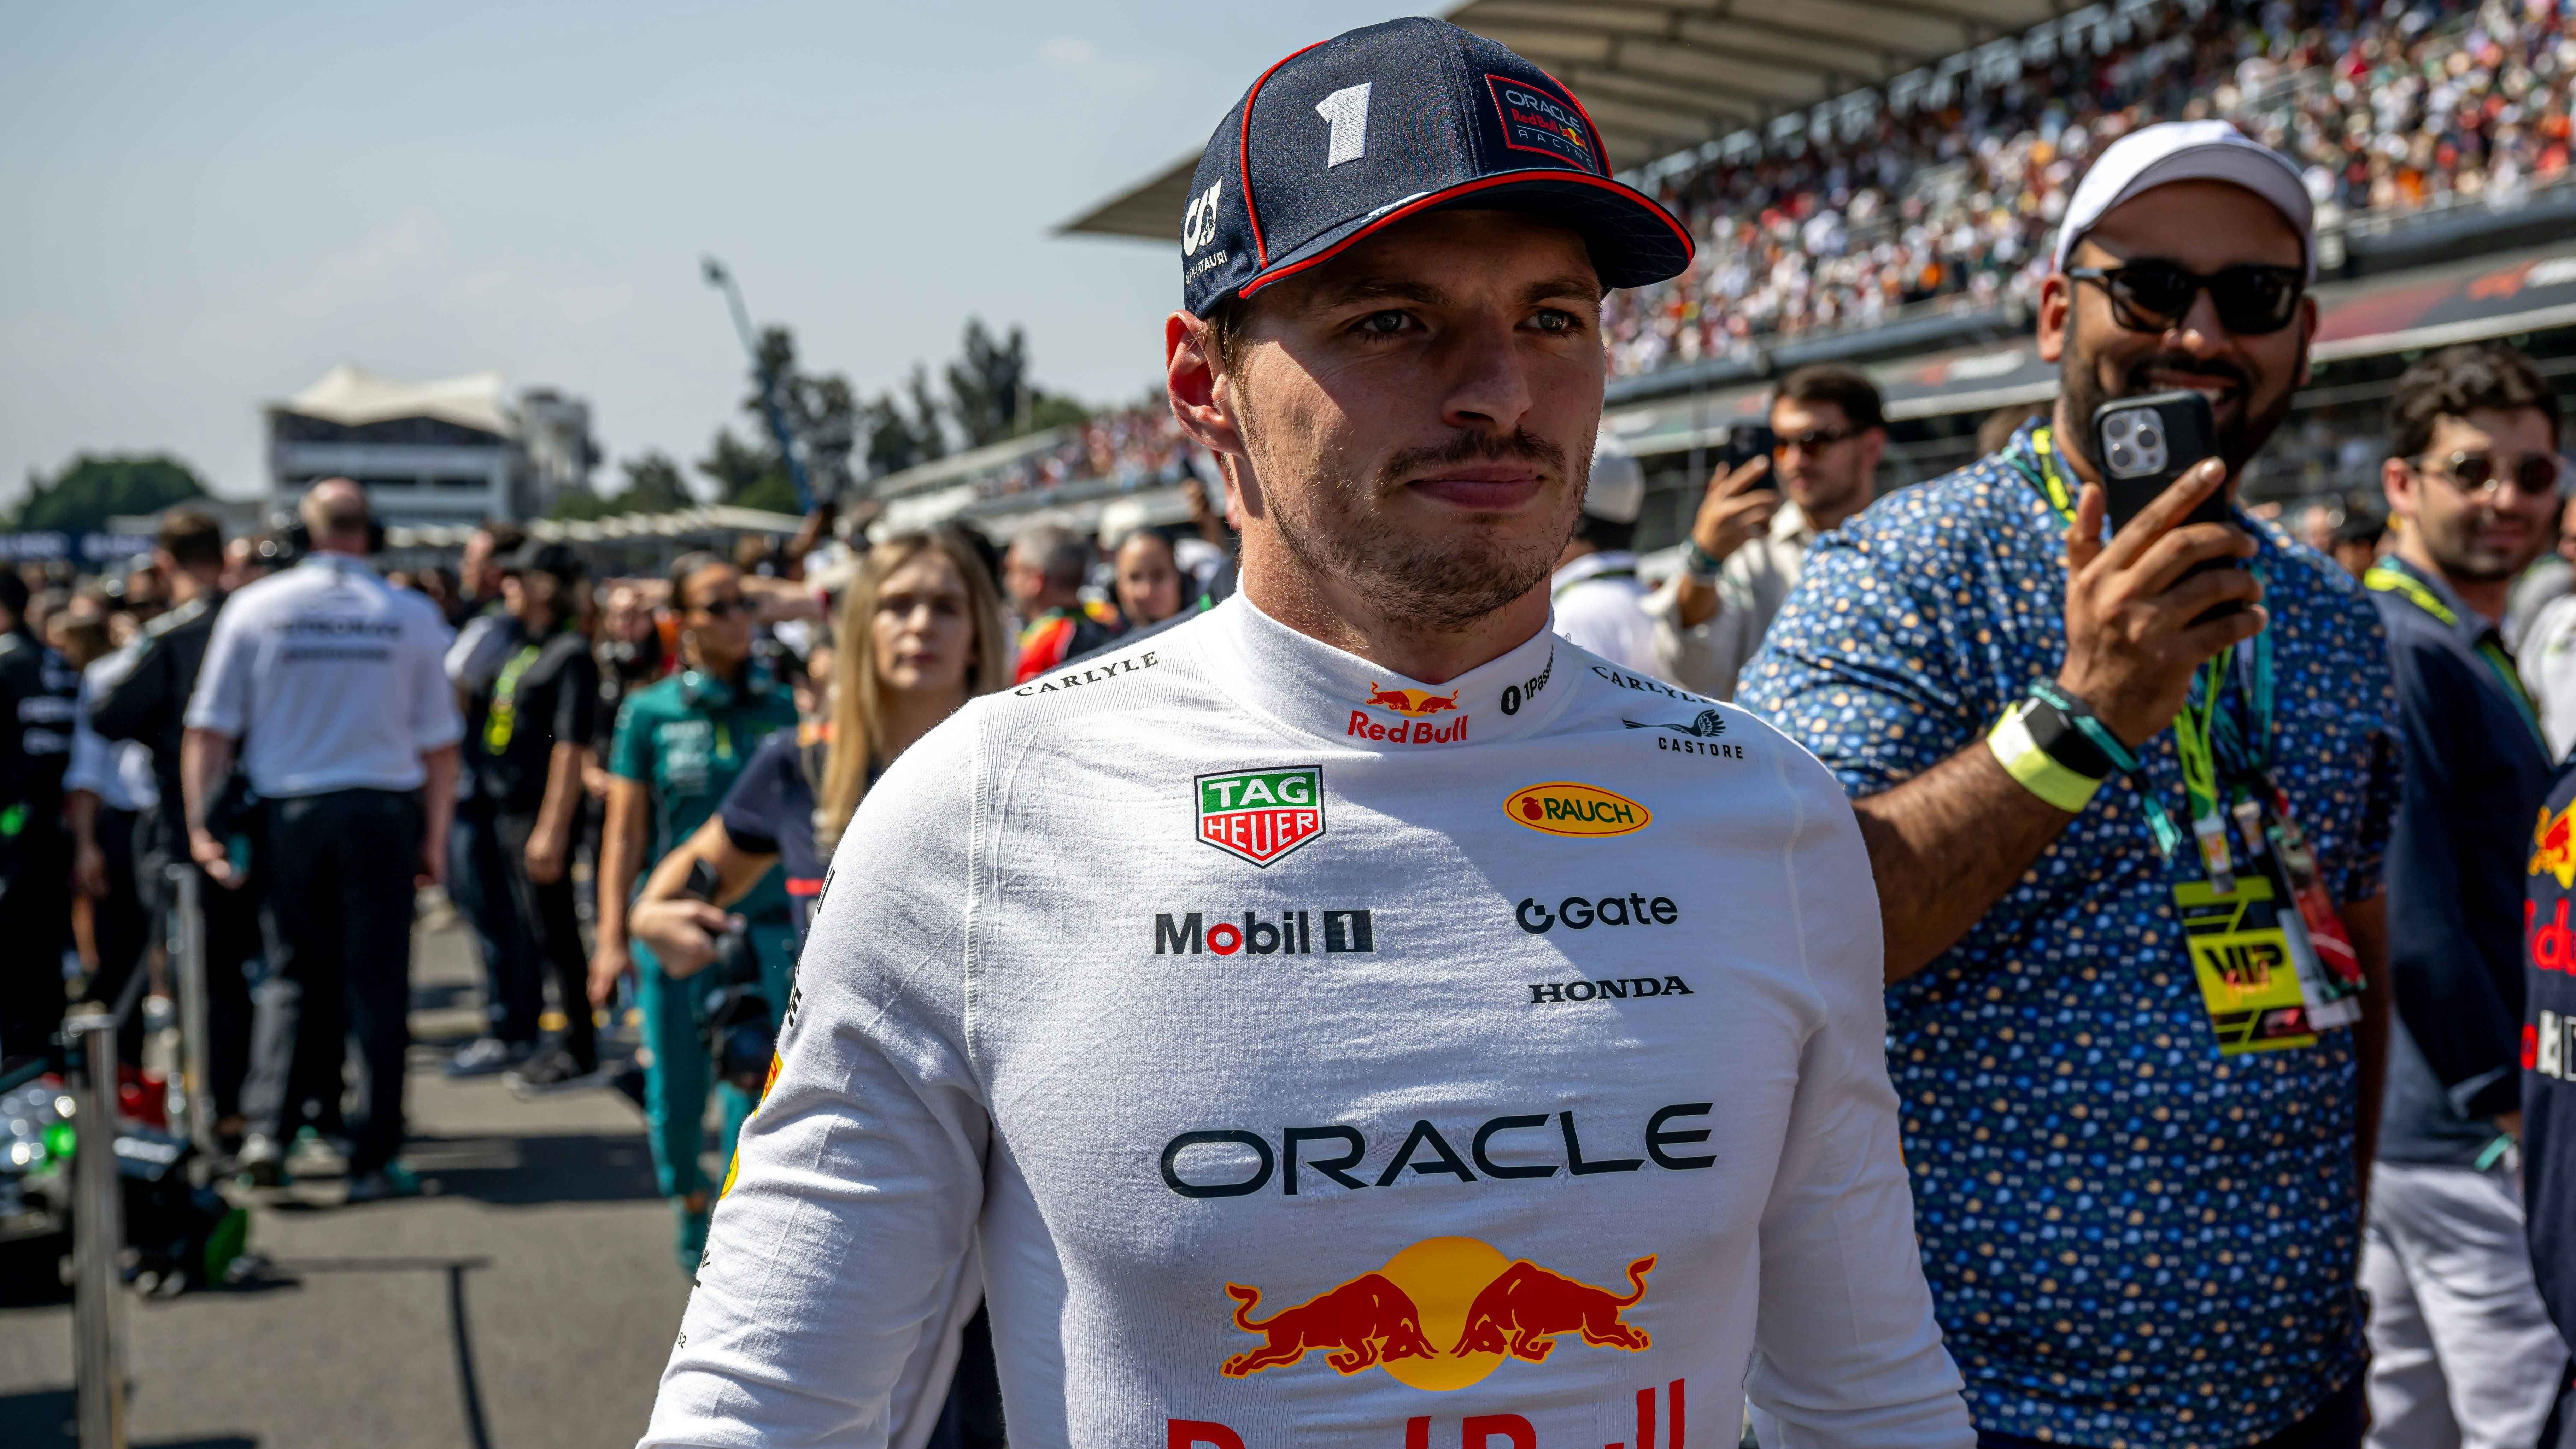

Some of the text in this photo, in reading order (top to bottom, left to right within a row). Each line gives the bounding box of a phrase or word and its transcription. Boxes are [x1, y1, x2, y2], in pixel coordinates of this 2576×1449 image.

[1315, 82, 1373, 168] 1
[1506, 90, 1582, 133] ORACLE
[1511, 108, 1560, 134] Red Bull
[1518, 130, 1593, 170] RACING
[1185, 250, 1228, 287] ALPHATAURI
[1014, 651, 1159, 697] CARLYLE
[1347, 710, 1468, 744] Red Bull
[1658, 737, 1744, 759] CASTORE
[1208, 776, 1309, 808] TAG
[1543, 797, 1635, 824] RAUCH
[1208, 812, 1313, 857] HEUER
[1559, 892, 1678, 930] Gate
[1155, 911, 1311, 955] Mobil
[2202, 944, 2283, 985] VIP
[1528, 976, 1694, 1004] HONDA
[1160, 1102, 1718, 1198] ORACLE
